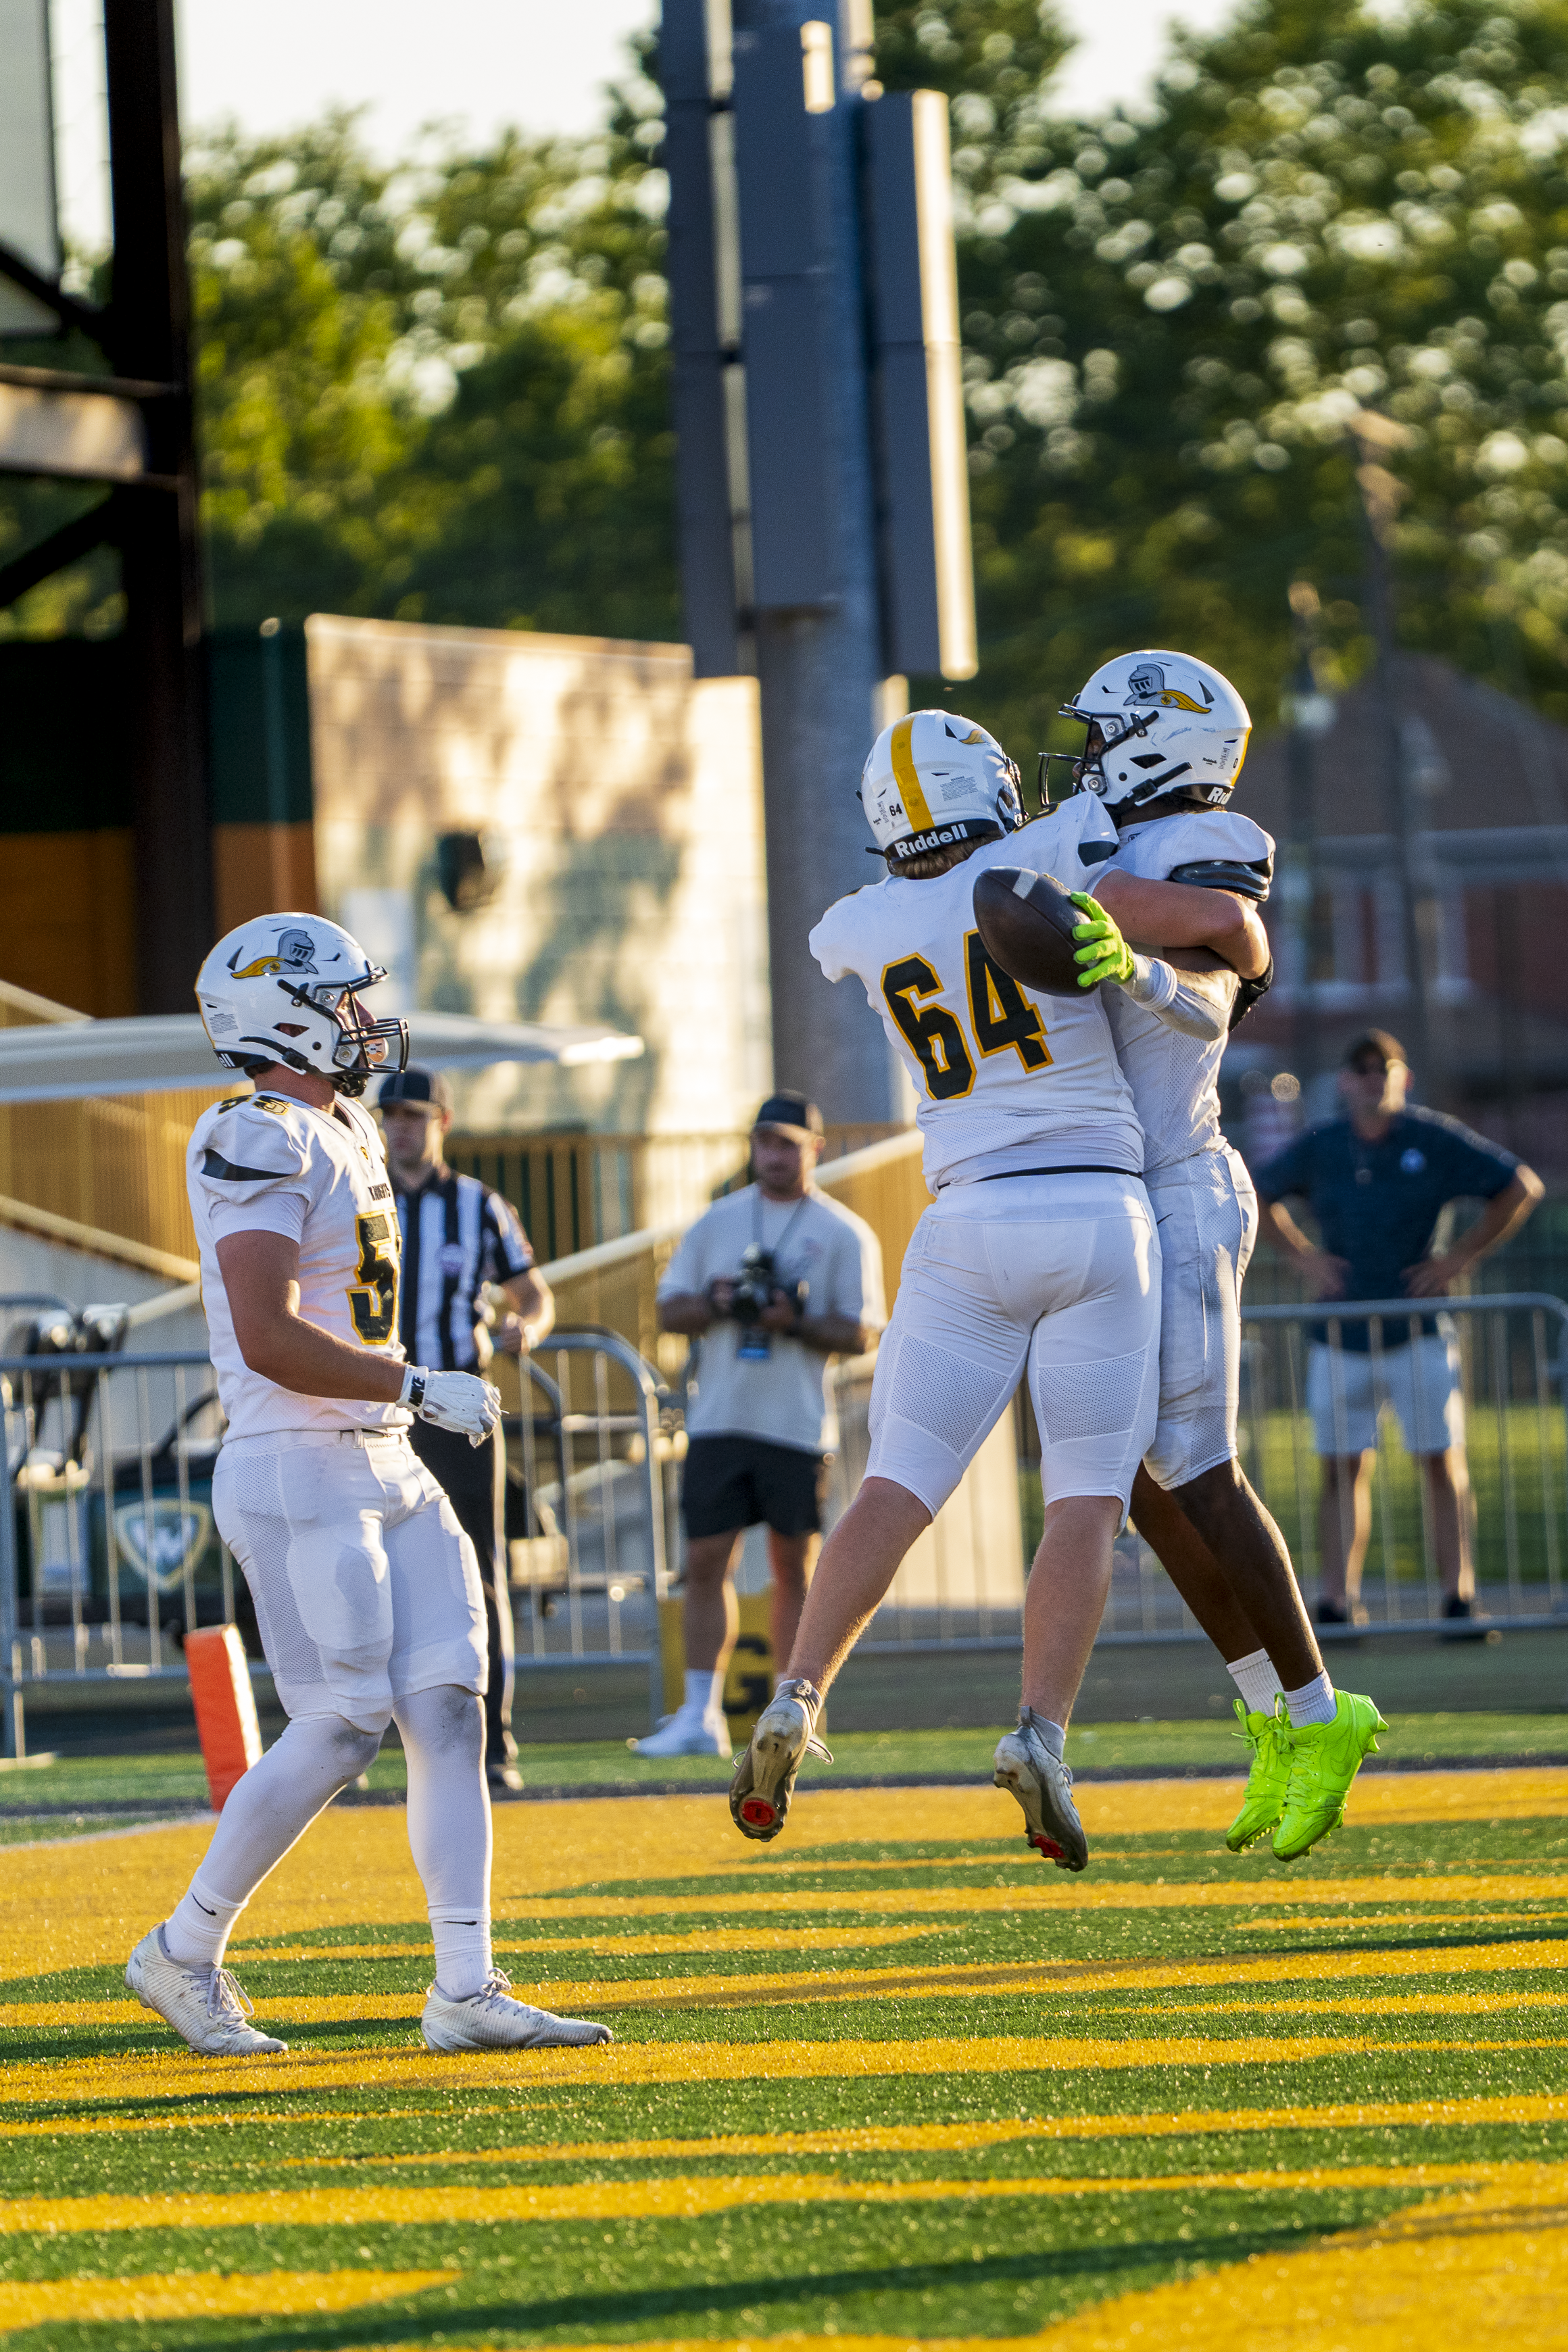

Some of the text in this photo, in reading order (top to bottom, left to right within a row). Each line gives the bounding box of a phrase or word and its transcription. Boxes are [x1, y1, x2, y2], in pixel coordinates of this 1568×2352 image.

[889, 803, 903, 816] 64
[894, 823, 968, 858] Riddell
[881, 928, 1054, 1100] 64
[345, 1207, 402, 1345] 5
[408, 1375, 425, 1407] NIKE
